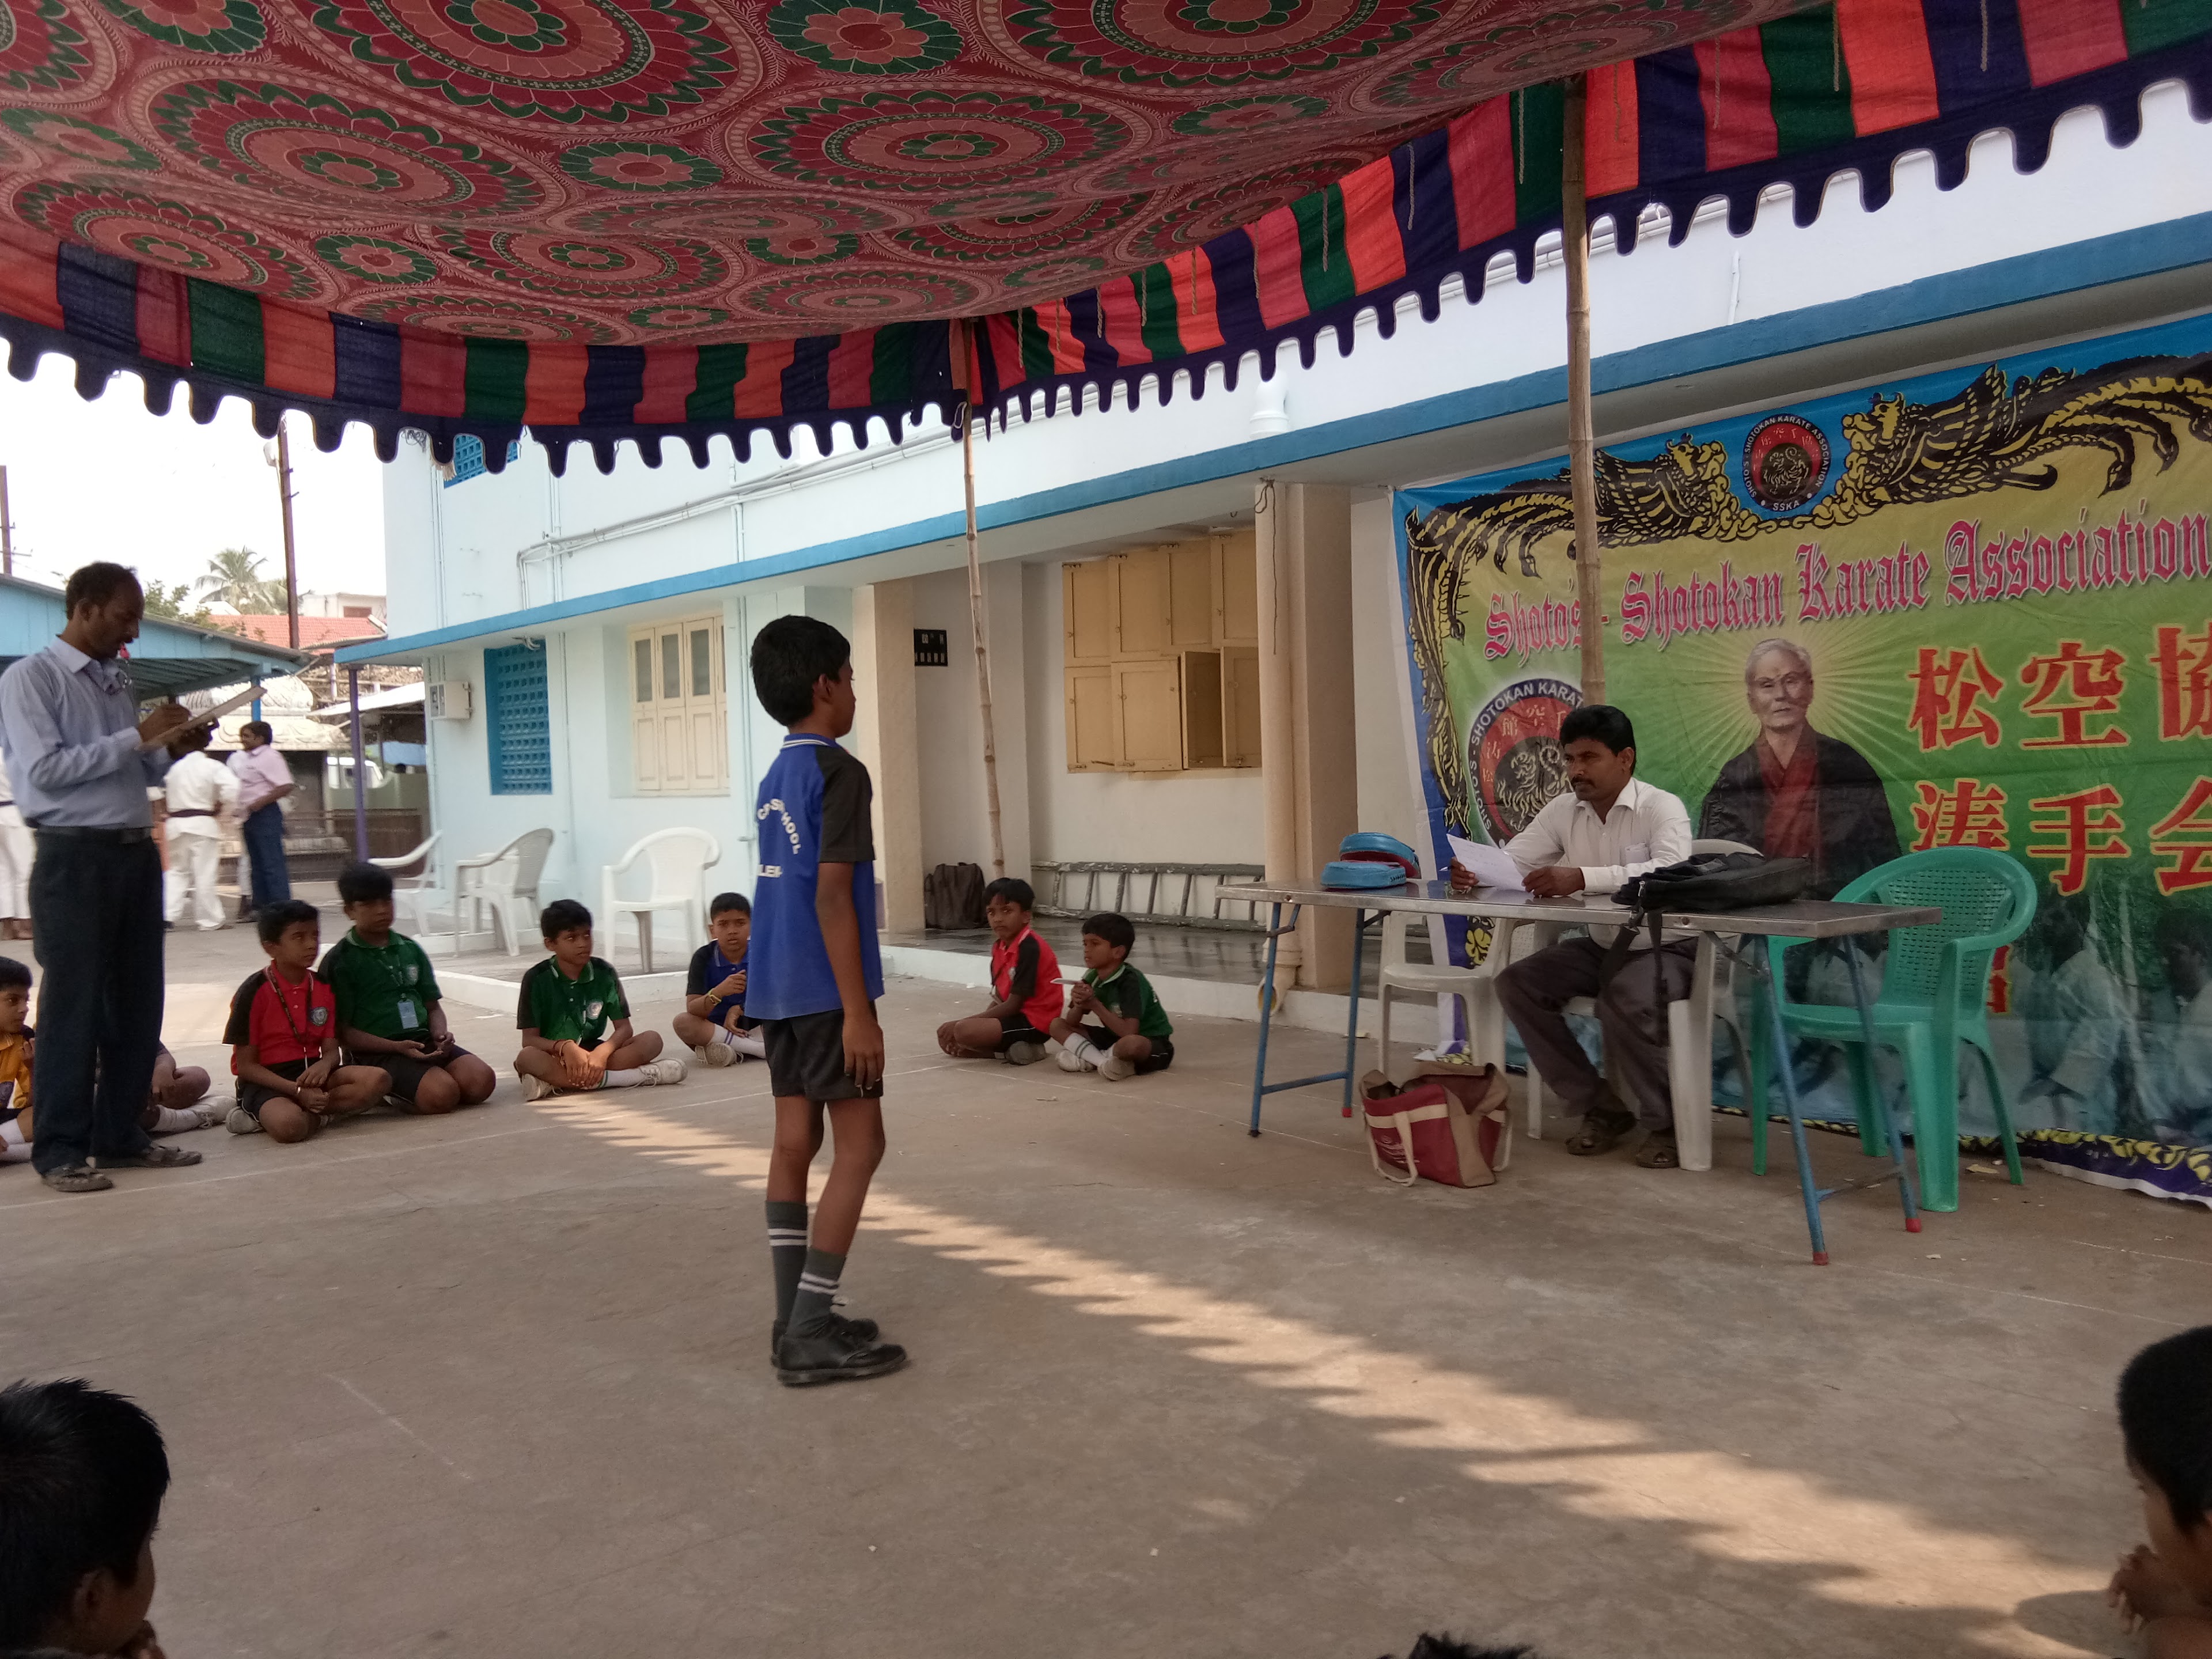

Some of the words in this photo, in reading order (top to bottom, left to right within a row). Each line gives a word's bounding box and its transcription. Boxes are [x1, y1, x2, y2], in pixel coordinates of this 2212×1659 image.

[1744, 417, 1776, 453] SHOTOKAN
[1778, 415, 1811, 430] KARATE
[1812, 429, 1830, 487] ASSOCIATION
[1743, 461, 1757, 498] SHOTOS
[1772, 499, 1800, 511] SSKA
[1620, 559, 1785, 652] Shotokan
[1796, 539, 1930, 623] Karate
[1945, 497, 2211, 607] Association
[1471, 682, 1534, 746] SHOTOKAN
